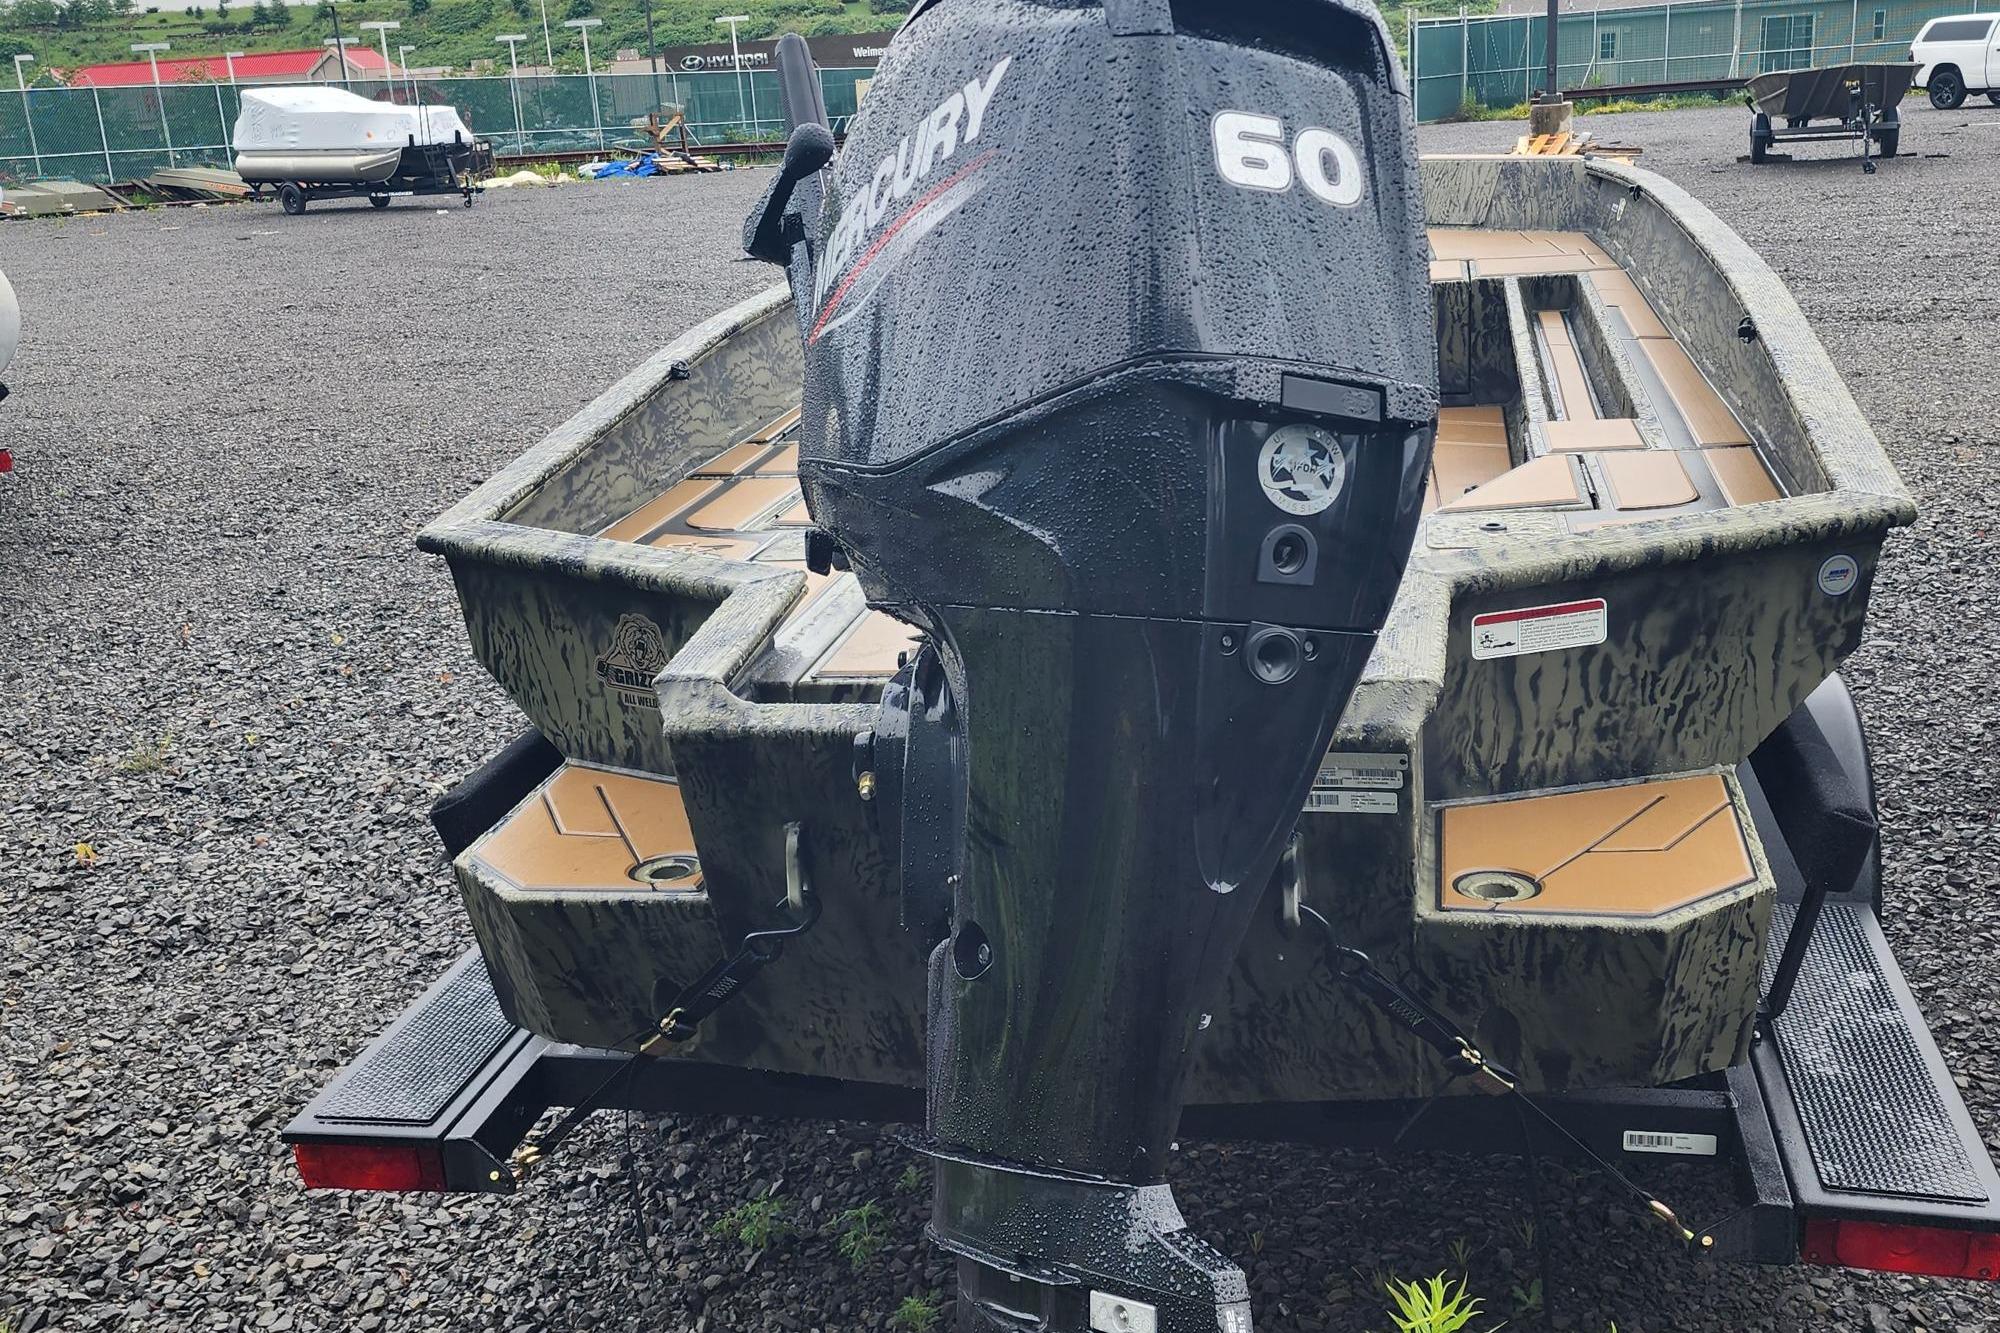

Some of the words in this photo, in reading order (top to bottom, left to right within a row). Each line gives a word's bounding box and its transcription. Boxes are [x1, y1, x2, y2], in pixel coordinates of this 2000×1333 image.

[706, 52, 769, 68] HYUNDAI
[1210, 109, 1364, 208] 60
[812, 56, 1013, 319] MERCURY
[624, 693, 637, 705] ALL
